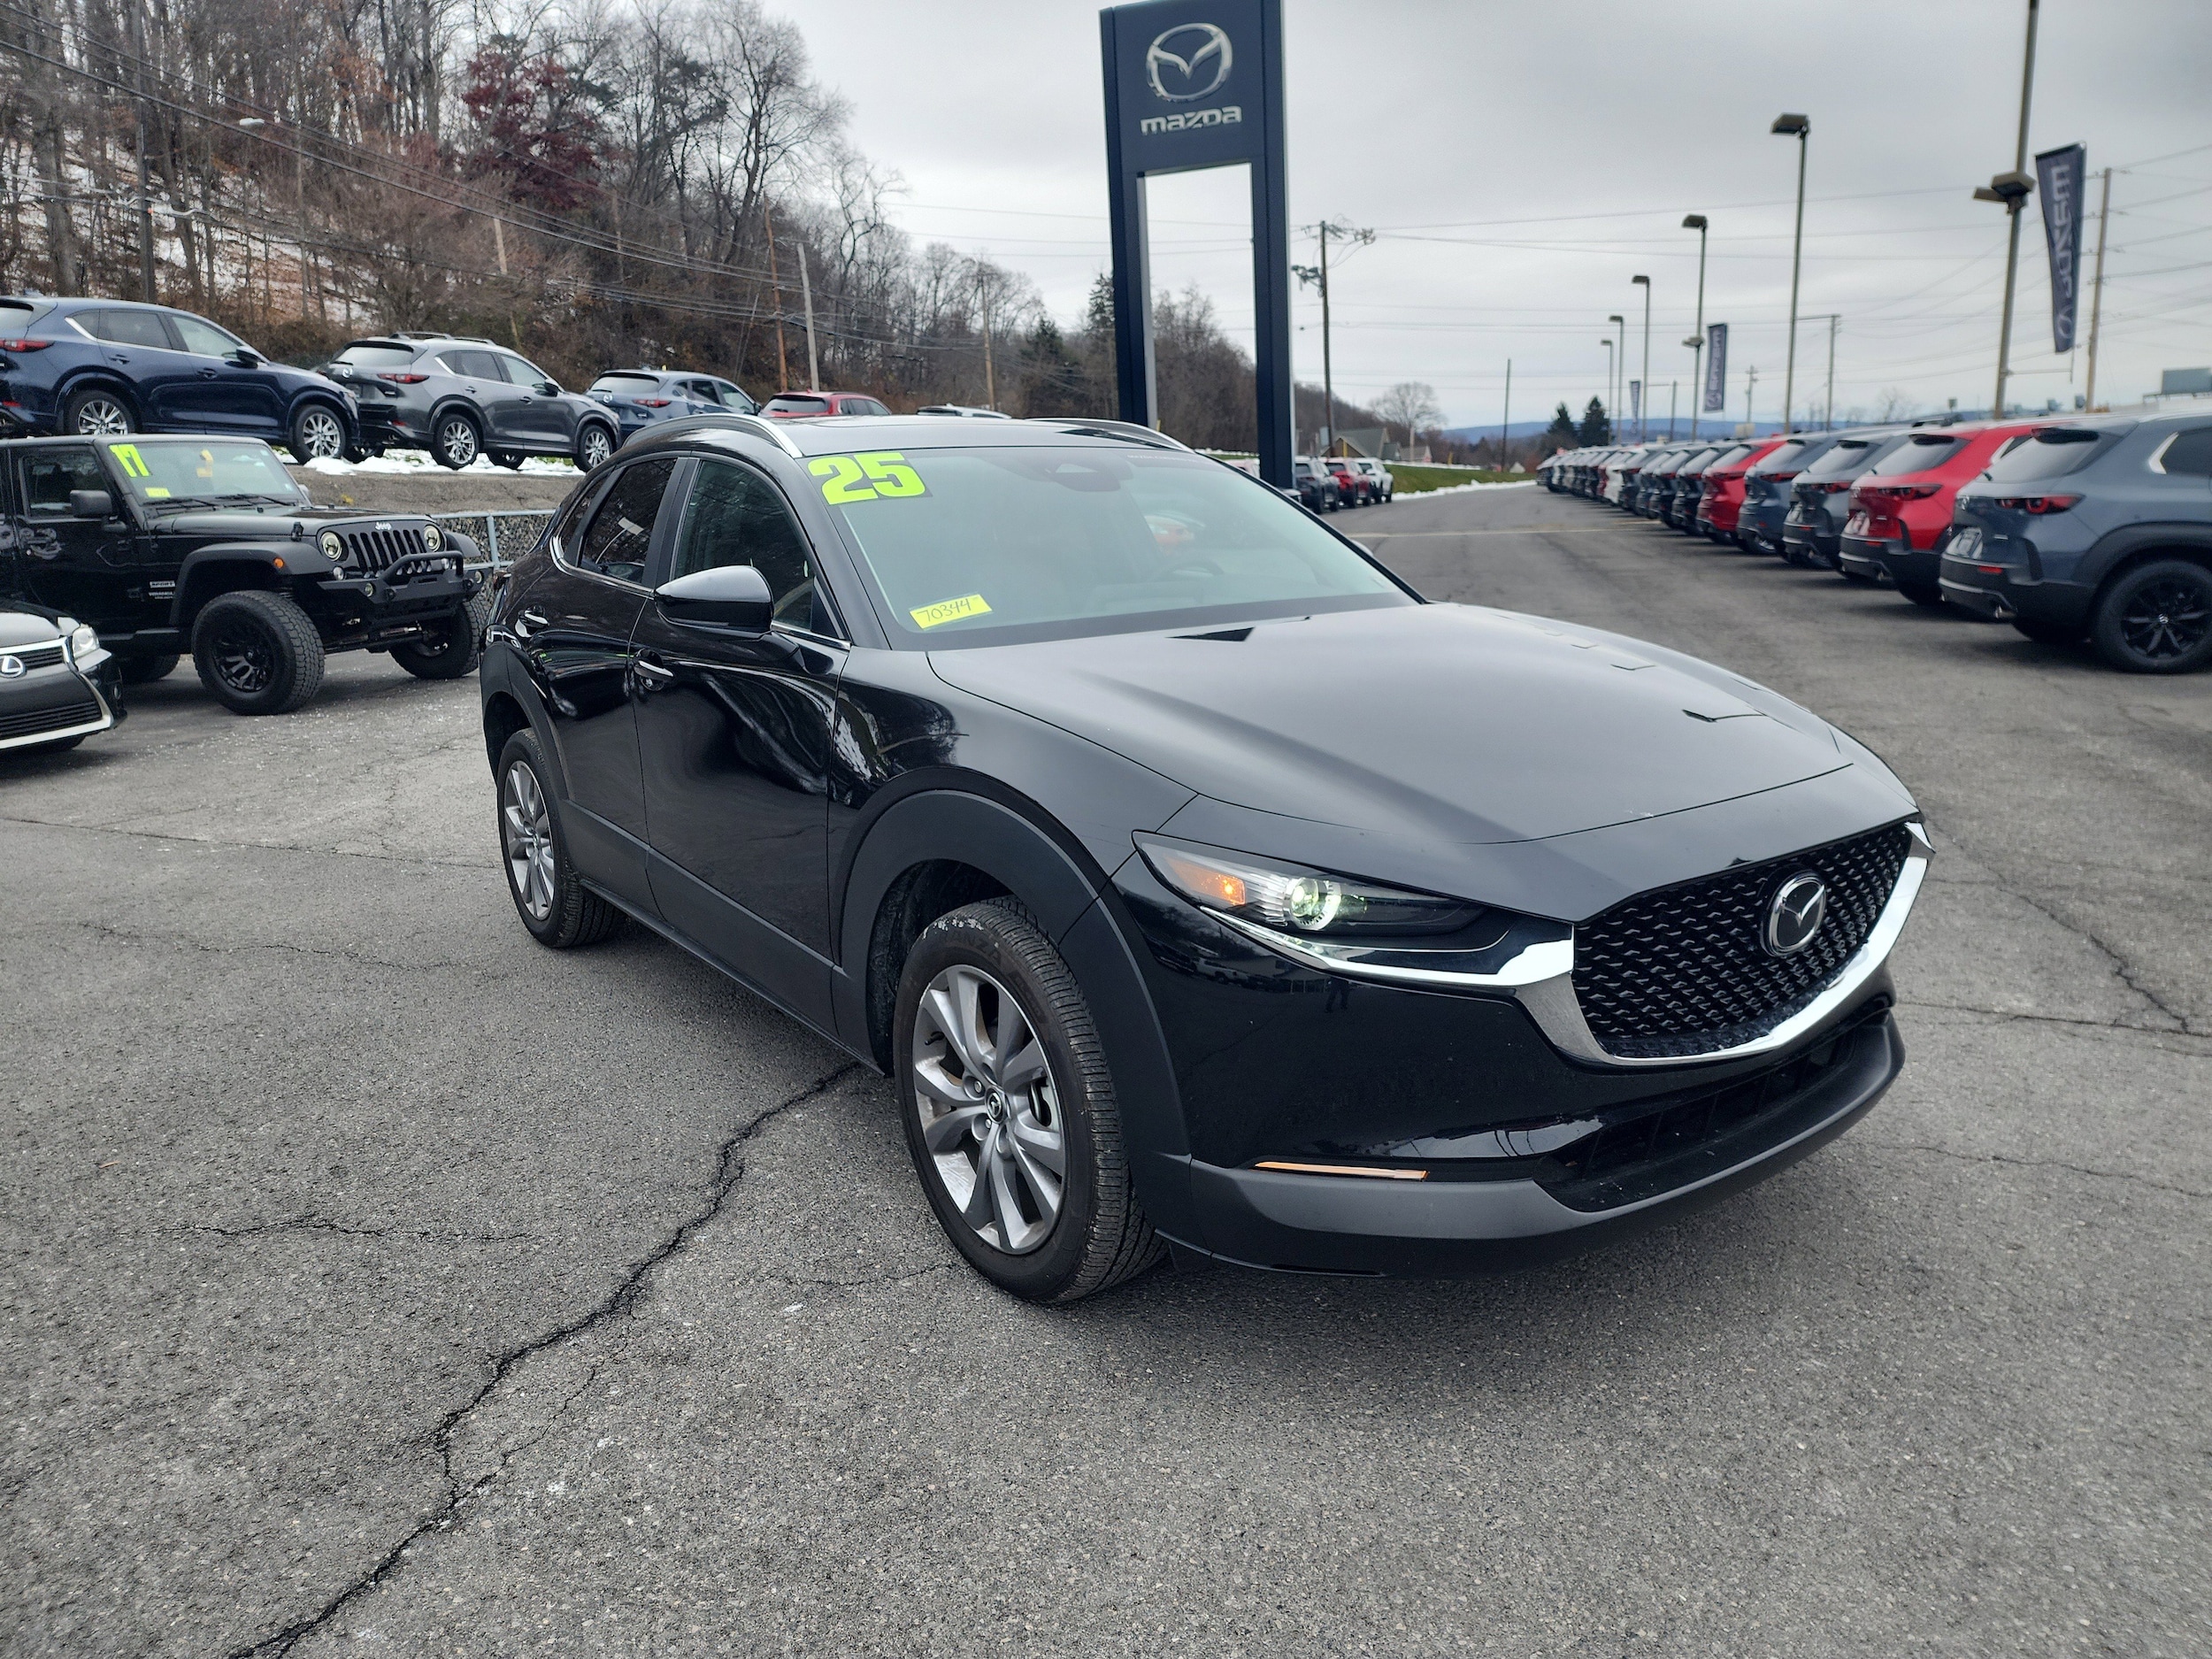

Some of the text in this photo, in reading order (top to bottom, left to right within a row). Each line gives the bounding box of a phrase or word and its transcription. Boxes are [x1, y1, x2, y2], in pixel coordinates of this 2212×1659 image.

[108, 443, 150, 477] 17
[807, 452, 926, 505] 25
[917, 598, 972, 622] 70344
